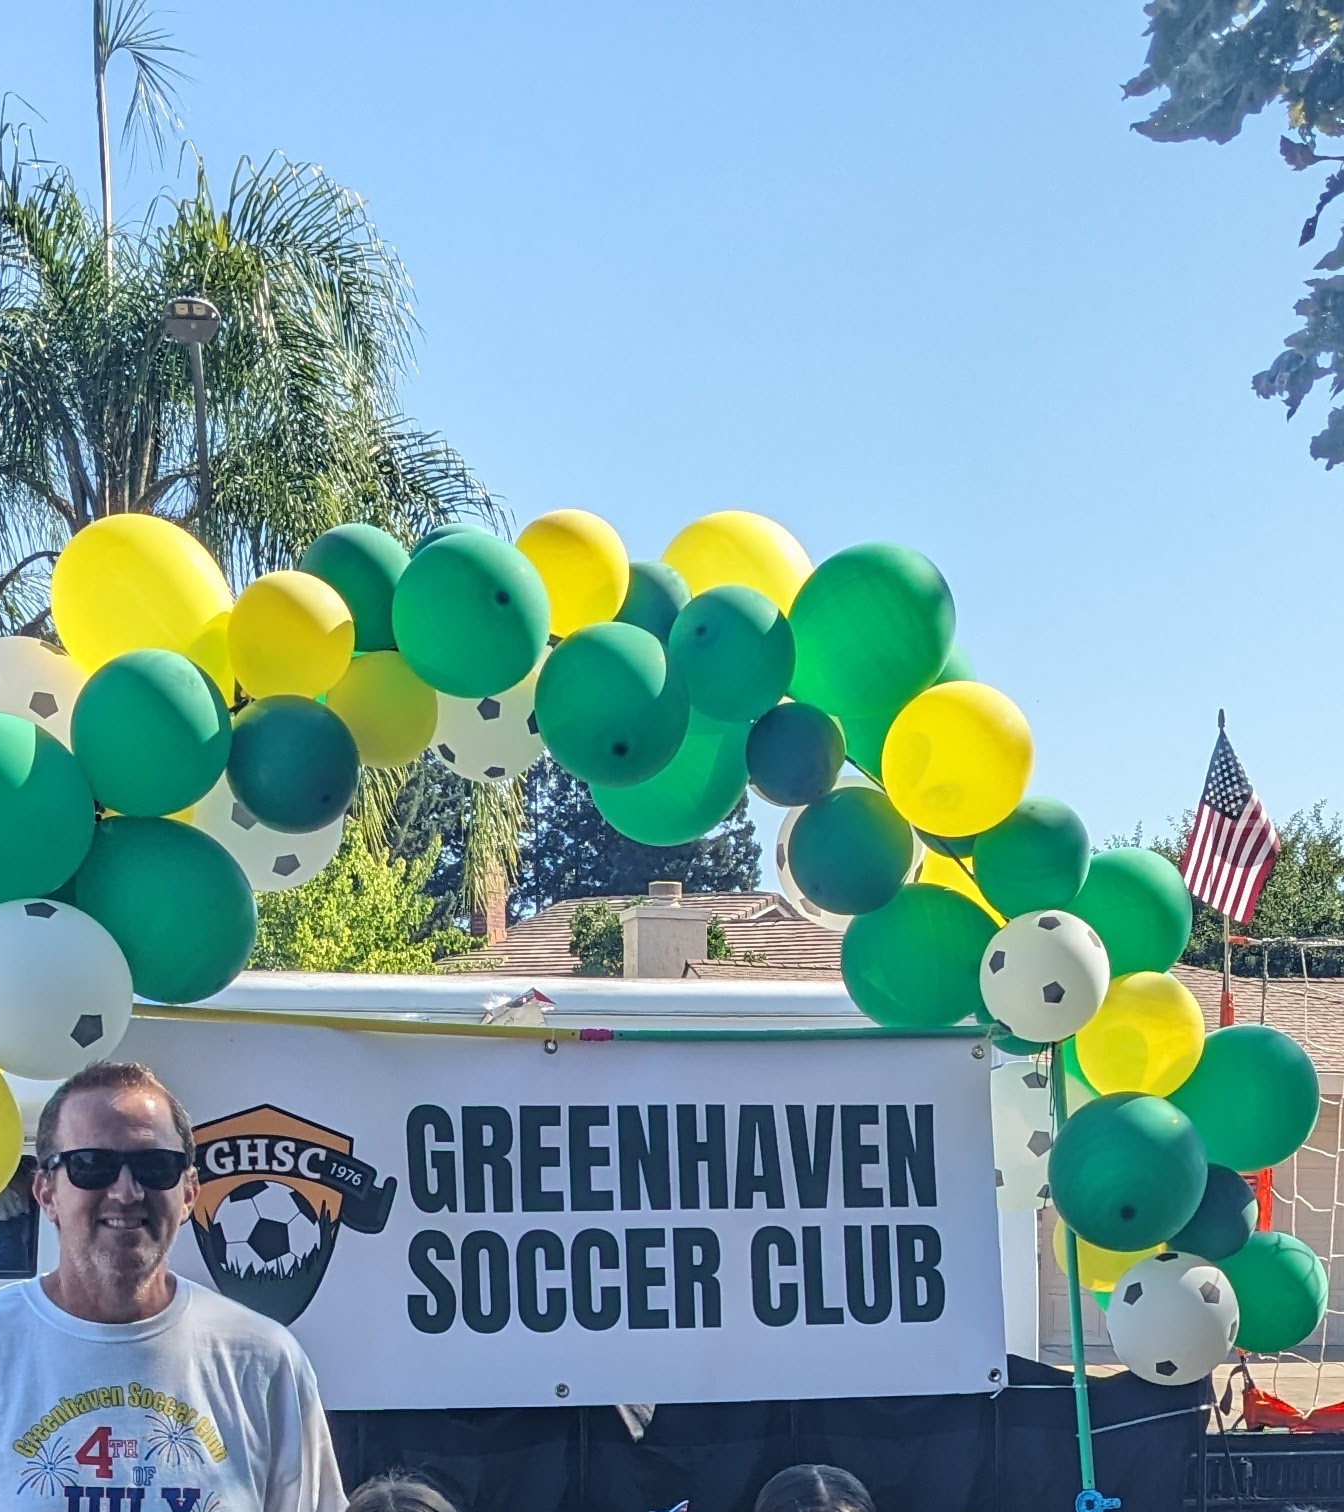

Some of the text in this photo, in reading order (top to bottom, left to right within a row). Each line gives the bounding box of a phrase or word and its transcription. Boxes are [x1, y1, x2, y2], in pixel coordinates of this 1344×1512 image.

[206, 1138, 327, 1180] GHSC
[329, 1162, 363, 1186] 1976
[406, 1103, 938, 1213] GREENHAVEN
[407, 1224, 946, 1334] SOCCER CLUB
[12, 1382, 228, 1463] Greenhaven Soccer Club
[74, 1426, 138, 1479] 4TH
[132, 1466, 157, 1486] OF
